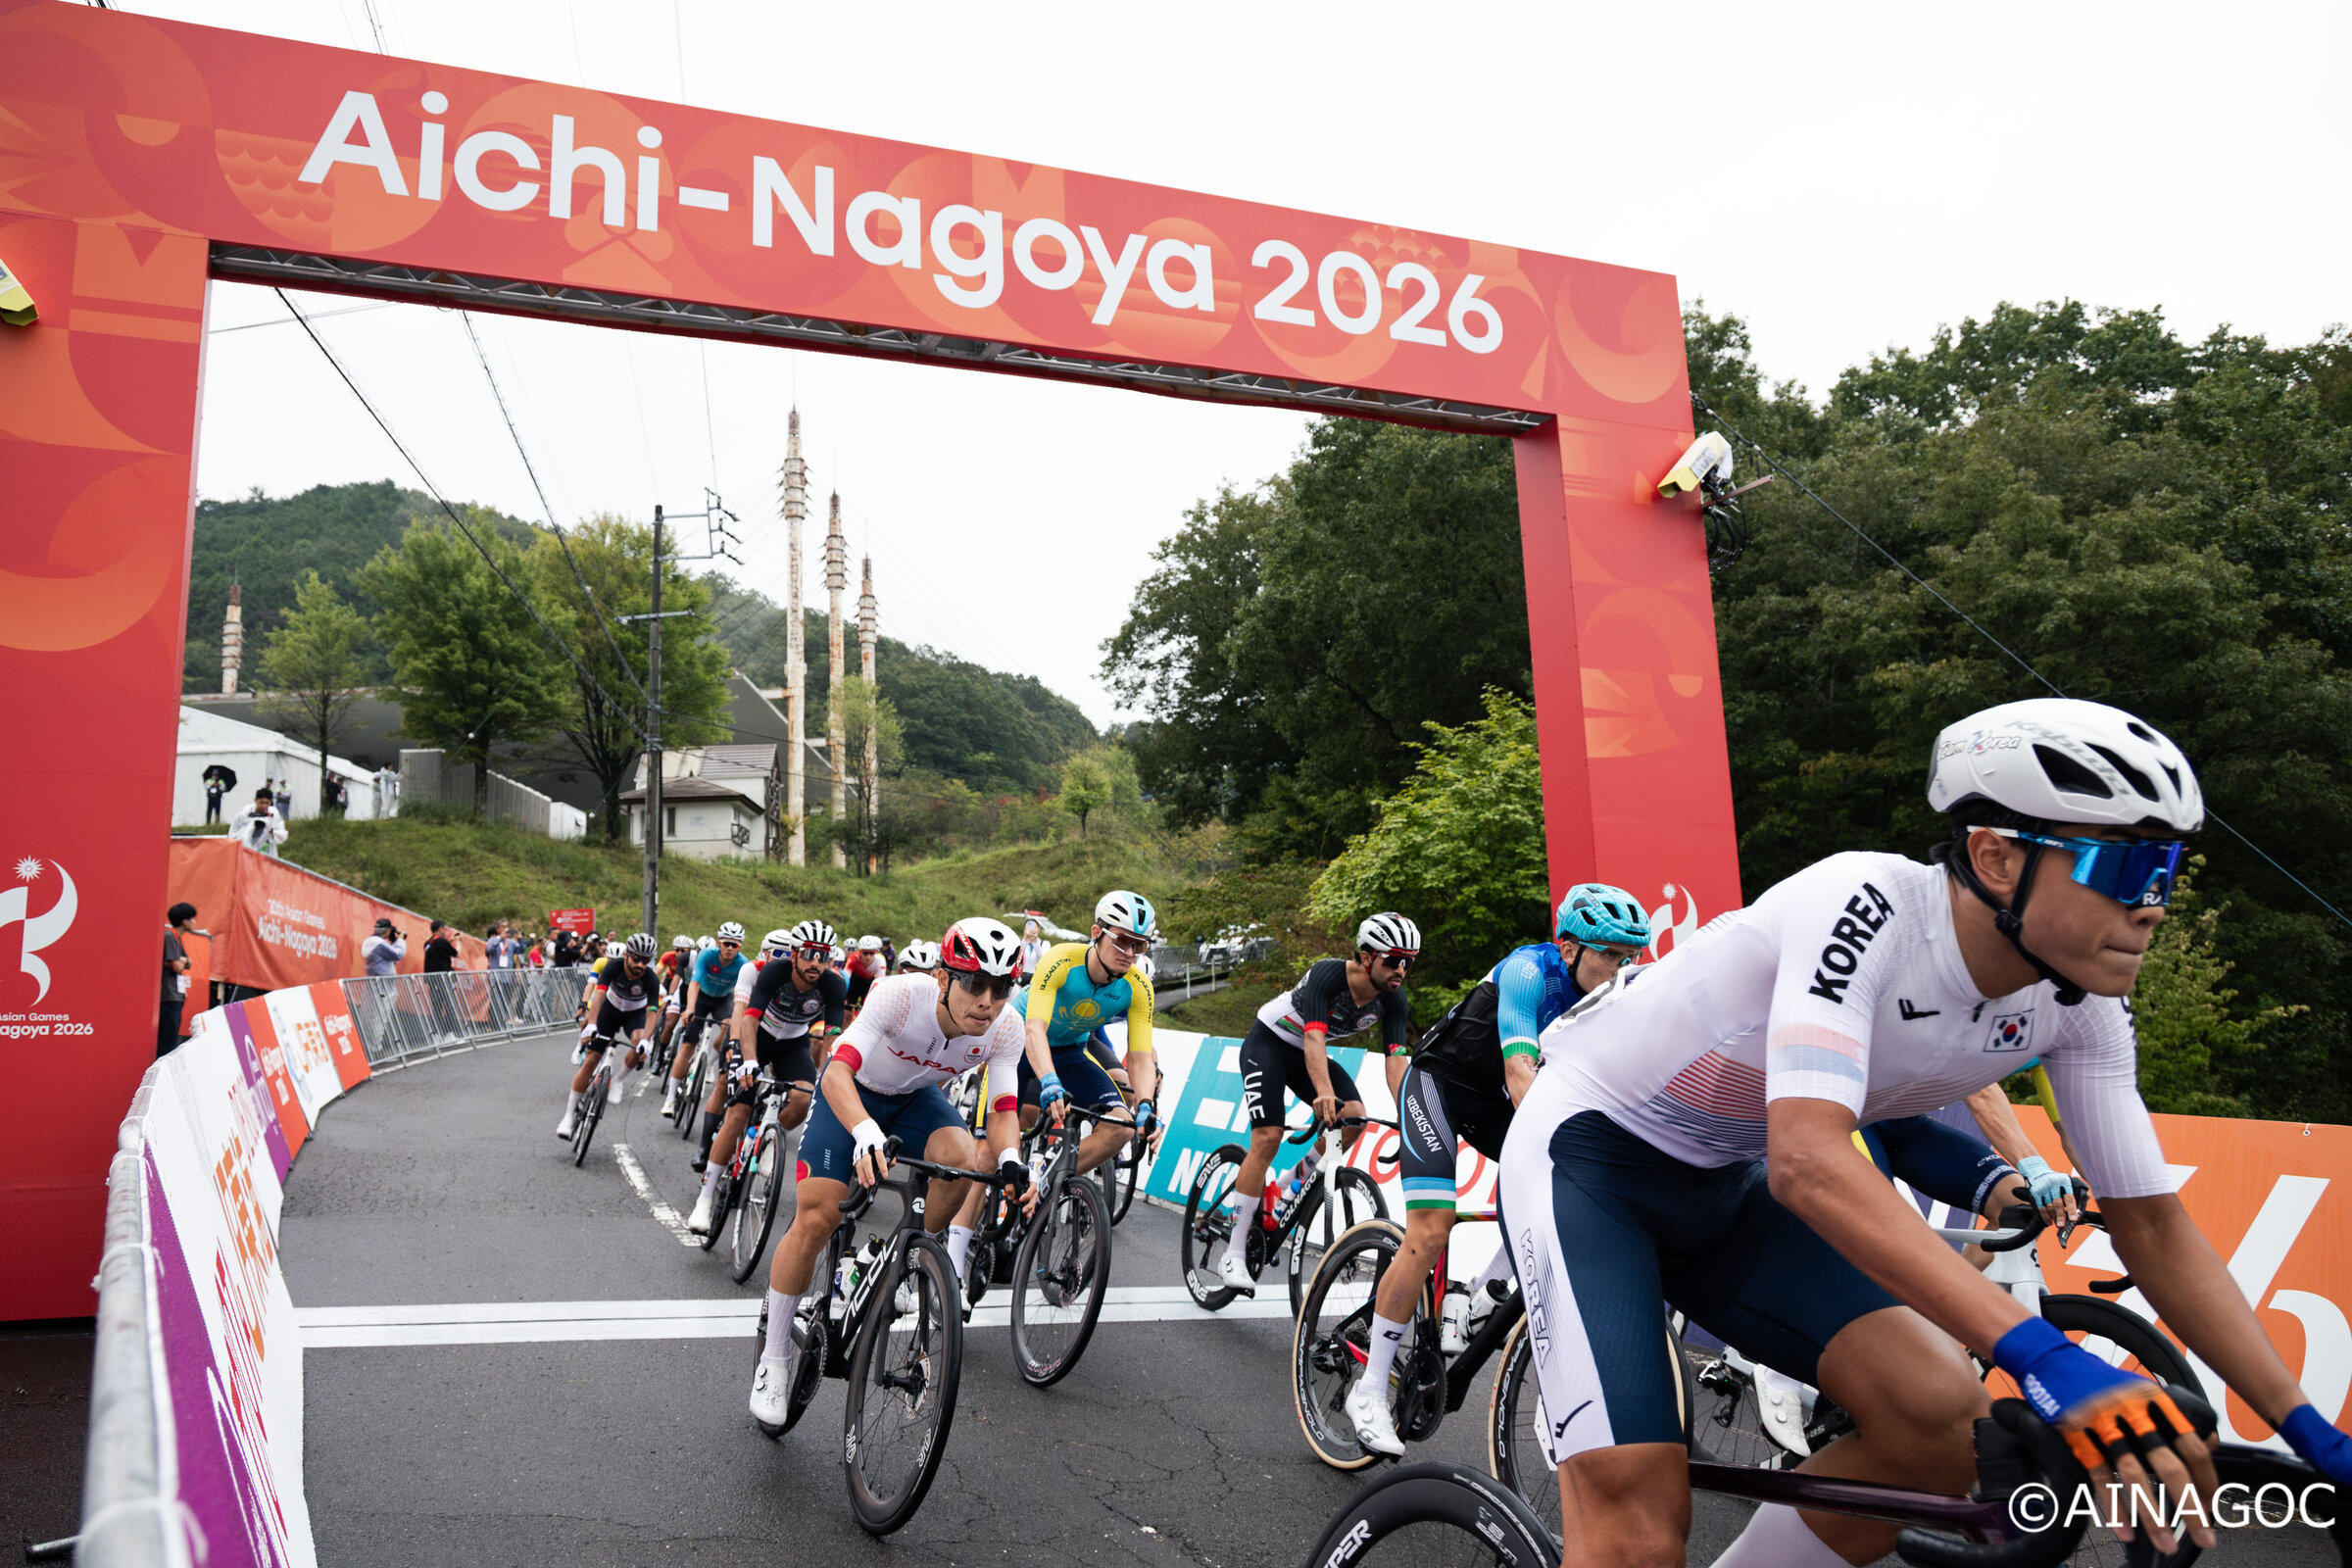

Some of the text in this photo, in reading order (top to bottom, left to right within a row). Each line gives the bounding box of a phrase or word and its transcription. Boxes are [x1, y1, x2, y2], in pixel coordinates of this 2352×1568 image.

[298, 90, 1503, 355] Aichi-Nagoya 2026
[258, 915, 337, 959] Aichi-Nagoya 2026
[1808, 882, 1894, 1004] KOREA
[0, 1012, 70, 1021] sian Games
[53, 1022, 94, 1036] 2026
[1243, 1070, 1265, 1122] UAE
[1406, 1094, 1443, 1152] UZBEKISTAN
[1279, 1171, 1318, 1229] COLNAGO
[1520, 1227, 1551, 1370] KOREA
[1297, 1321, 1325, 1442] CAMPAGNOLO
[1497, 1326, 1531, 1458] MPAGNOLO
